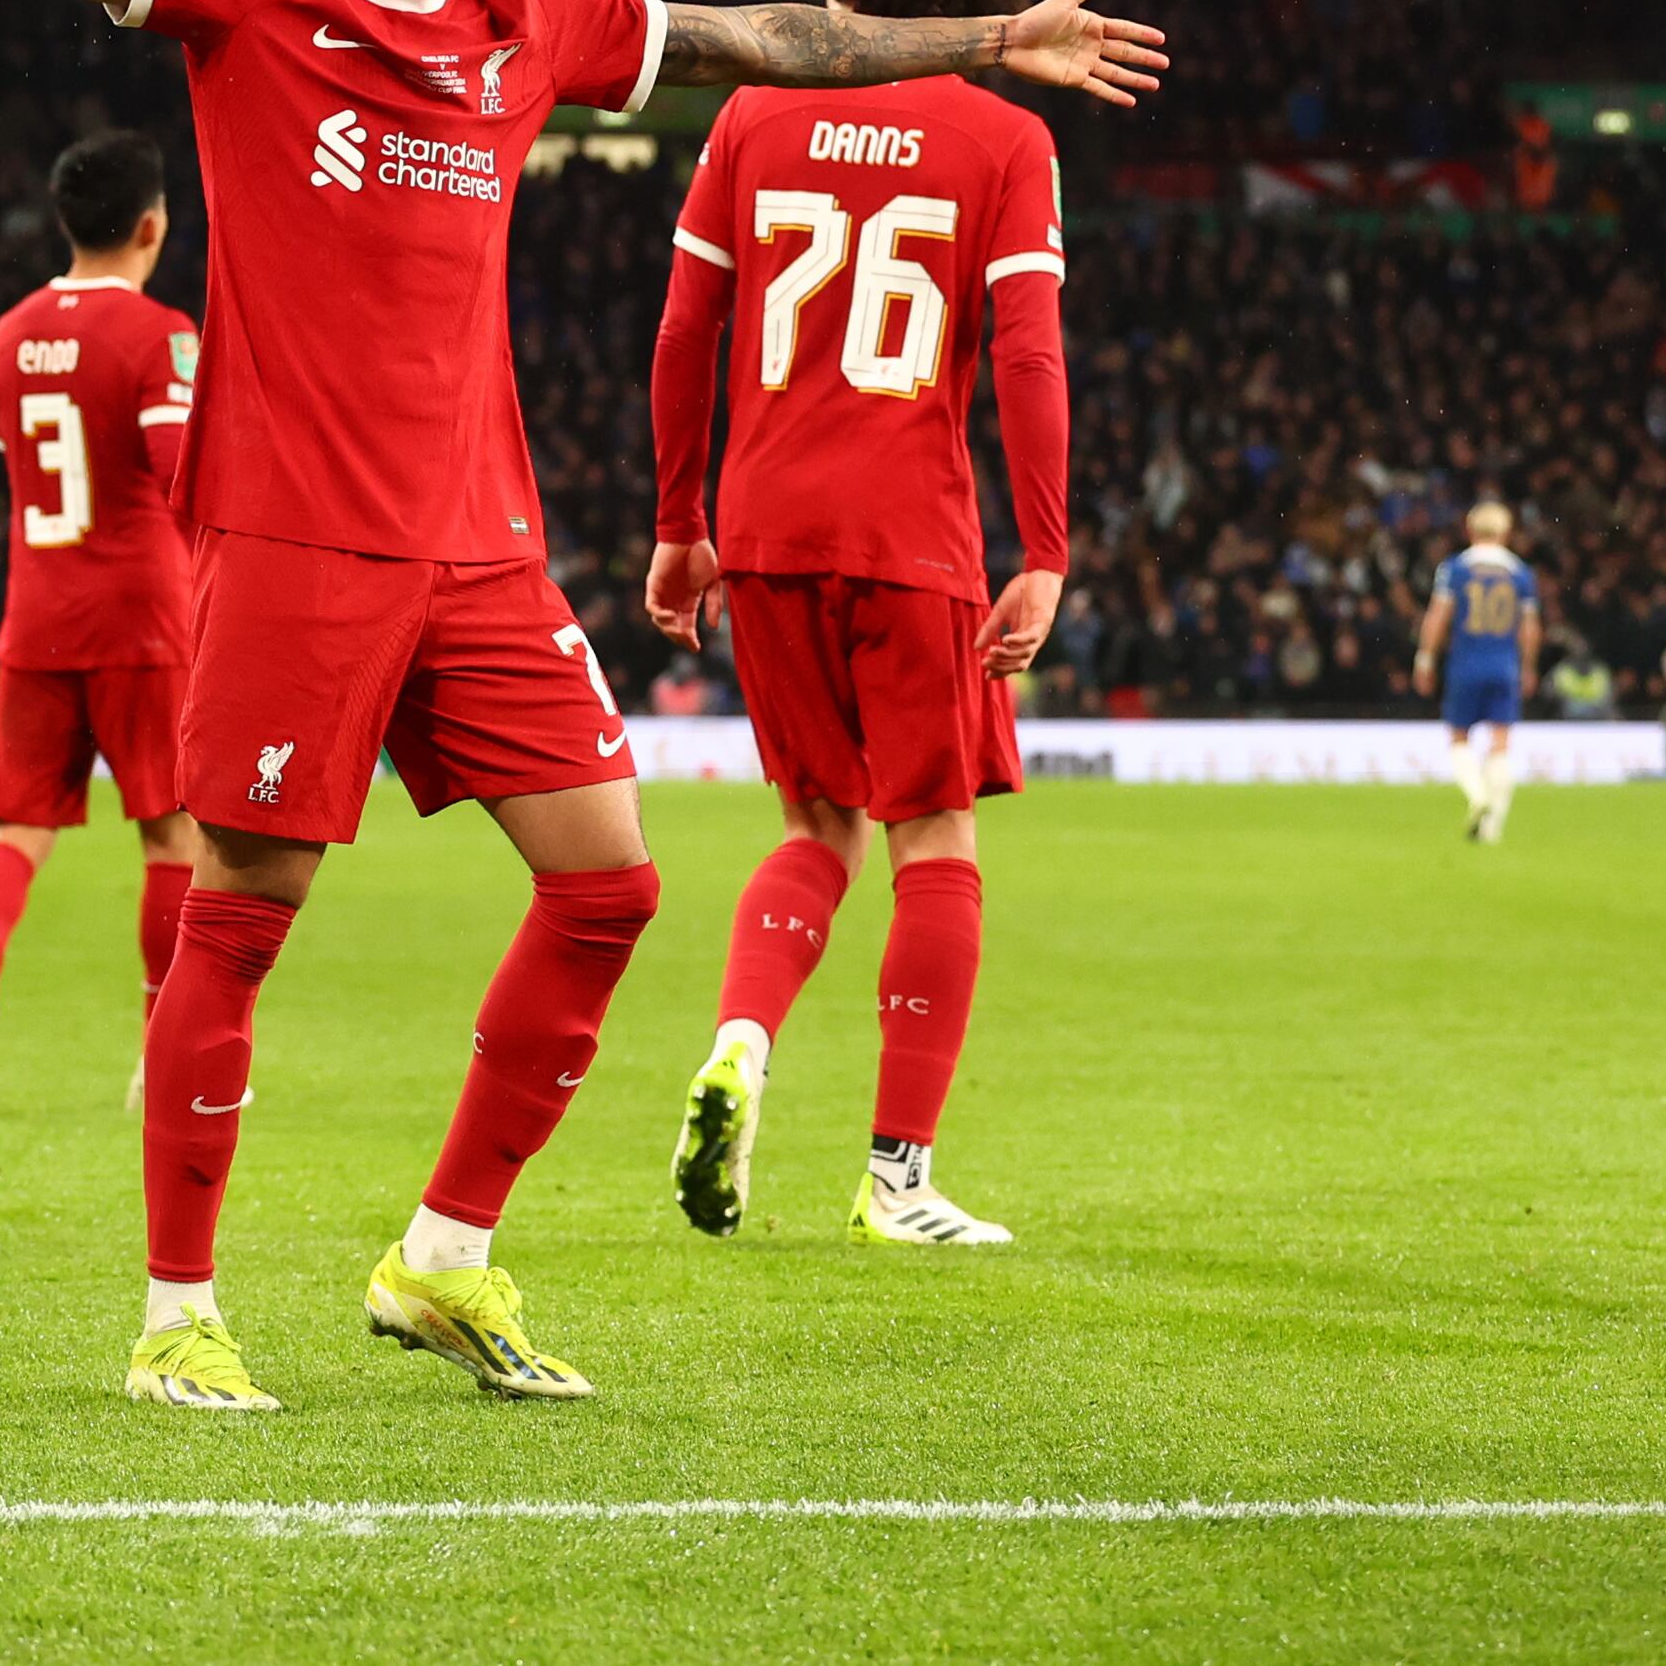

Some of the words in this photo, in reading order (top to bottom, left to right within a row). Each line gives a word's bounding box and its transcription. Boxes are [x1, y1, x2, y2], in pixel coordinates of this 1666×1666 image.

[439, 63, 446, 71] V
[450, 55, 459, 63] FC
[379, 130, 495, 176] standard
[377, 158, 502, 203] chartered
[754, 189, 961, 402] 76
[20, 391, 92, 548] 3
[1463, 577, 1518, 638] 10
[552, 623, 618, 717] 7
